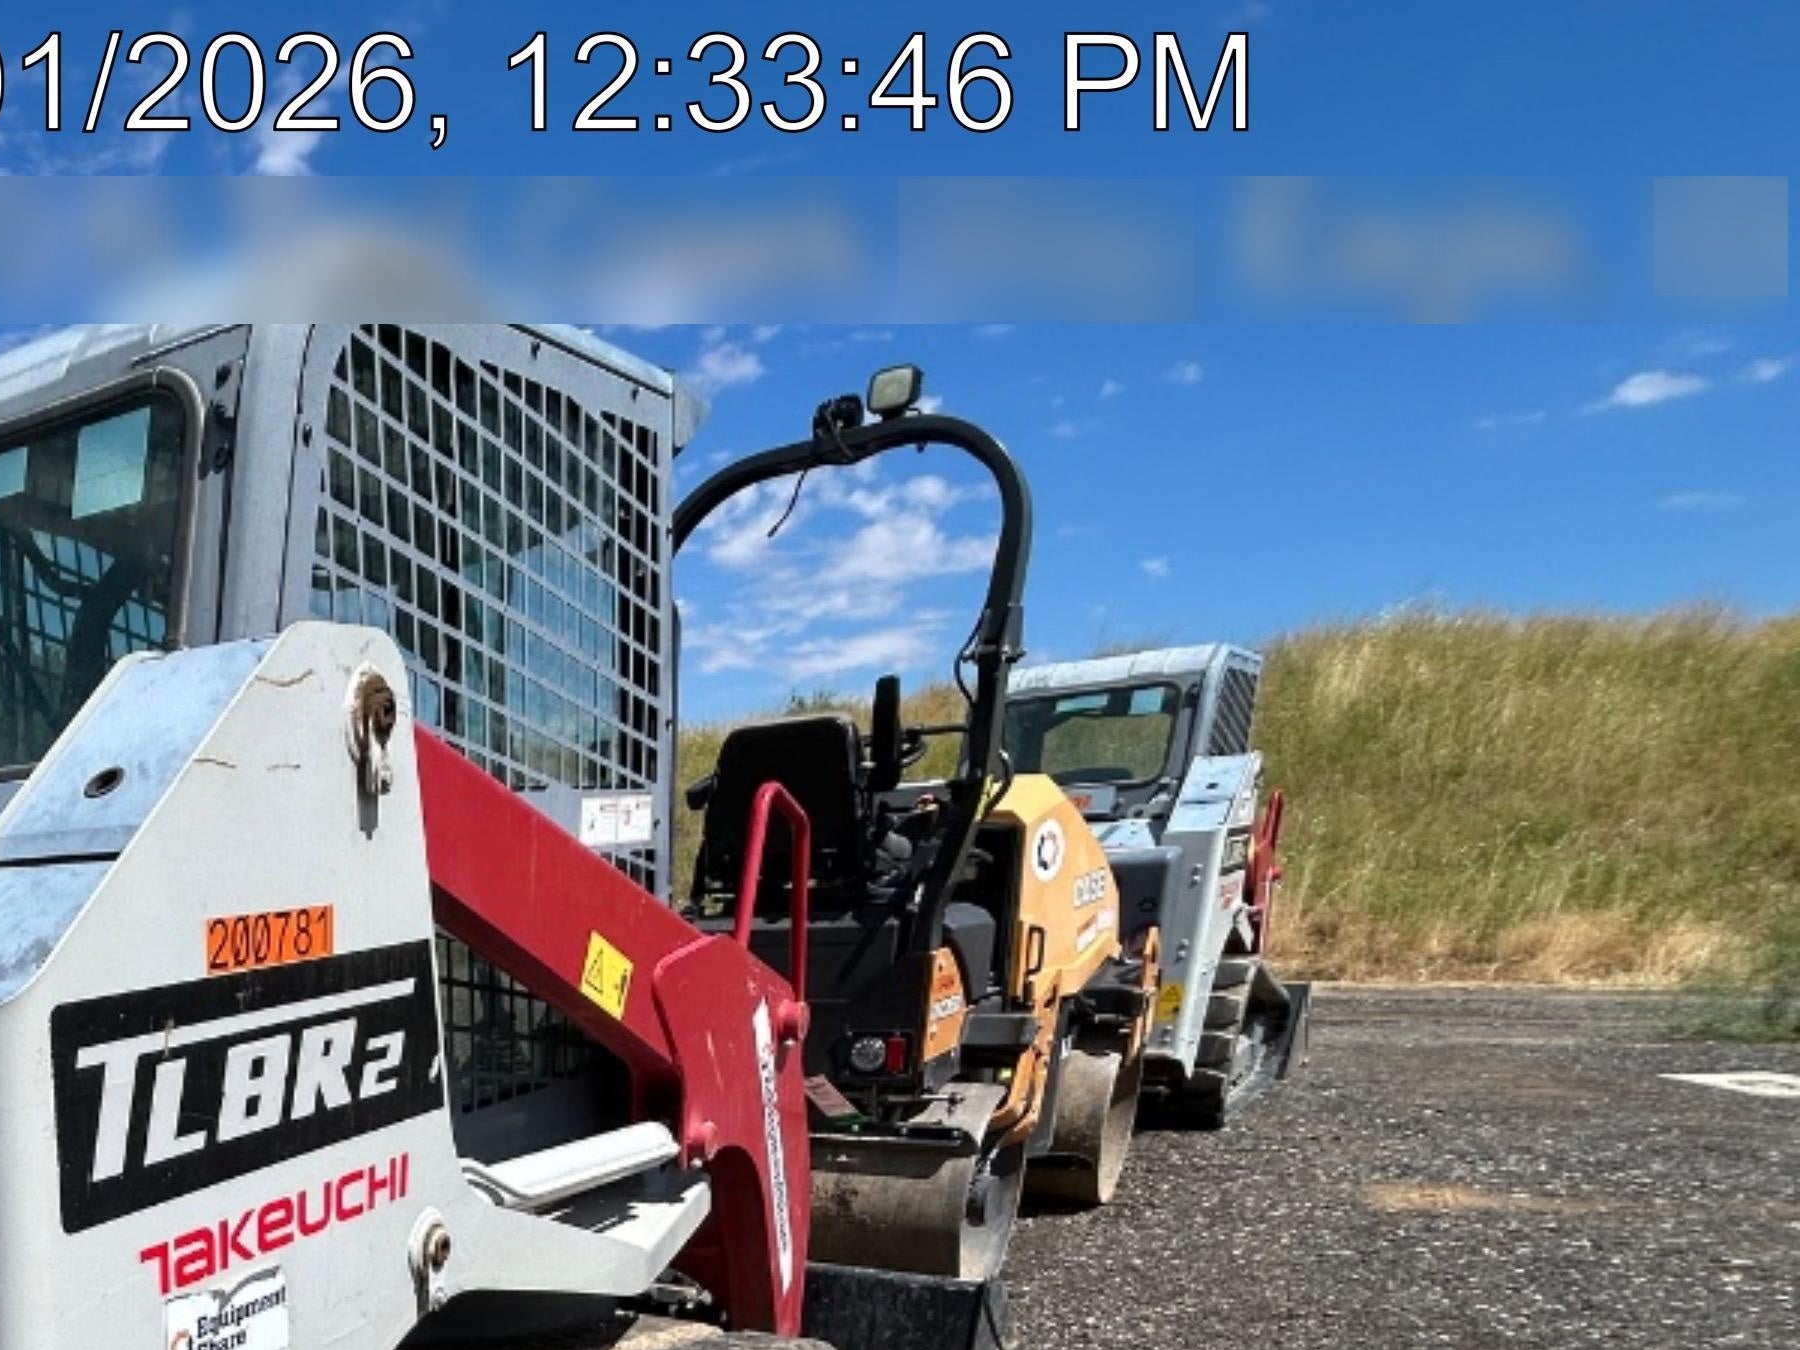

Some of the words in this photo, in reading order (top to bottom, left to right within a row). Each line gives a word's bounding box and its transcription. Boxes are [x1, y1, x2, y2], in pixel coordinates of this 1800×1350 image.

[208, 905, 329, 970] 200781
[139, 1152, 410, 1295] TAKEUCHI
[197, 1285, 287, 1339] Equipment
